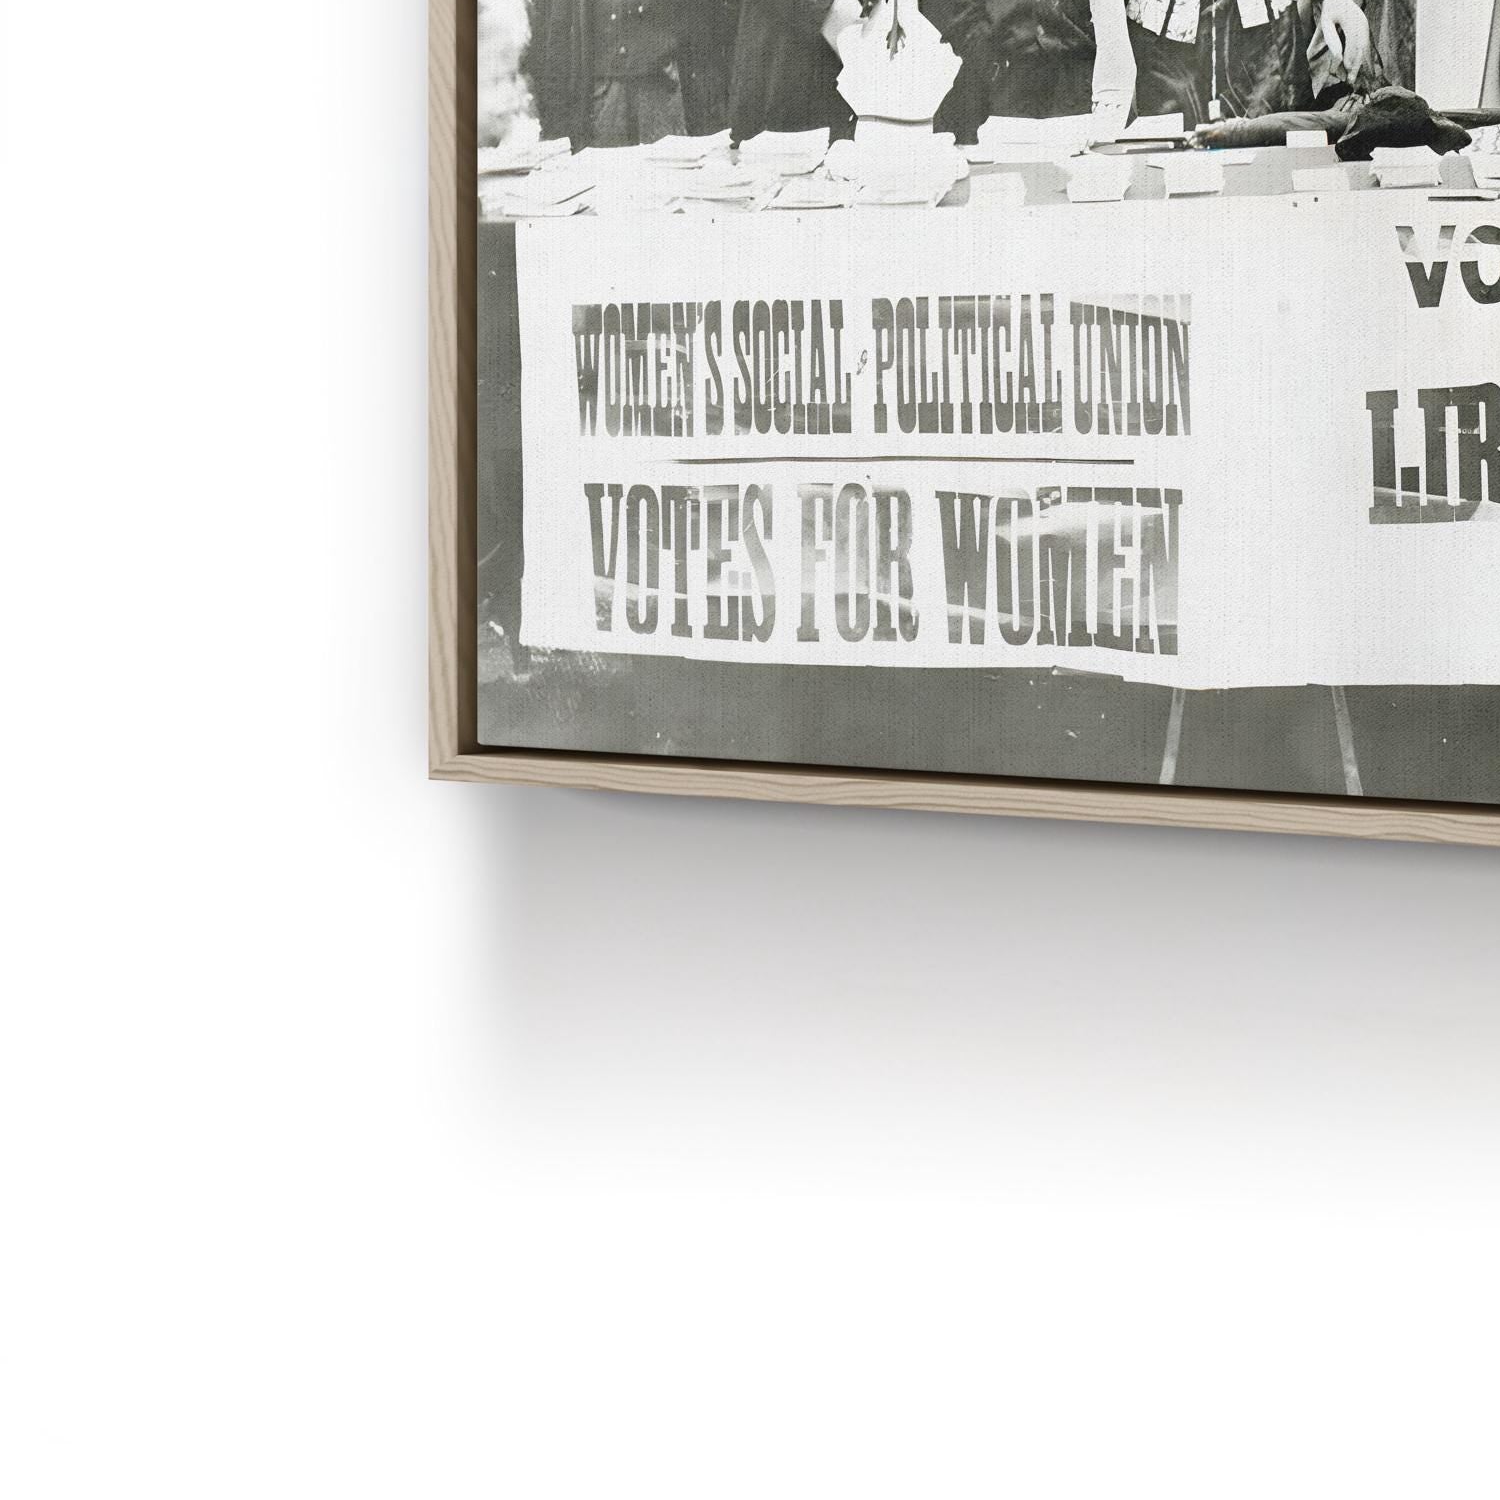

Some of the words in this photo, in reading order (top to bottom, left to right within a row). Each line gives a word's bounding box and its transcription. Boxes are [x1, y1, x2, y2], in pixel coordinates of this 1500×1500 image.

[571, 299, 726, 438] WOMEN'S
[731, 298, 853, 436] SOCIAL
[871, 292, 1064, 436] POLITICAL
[1068, 294, 1193, 438] UNION
[583, 482, 778, 645] VOTES
[795, 481, 922, 645] FOR
[933, 484, 1185, 657] WOMEN
